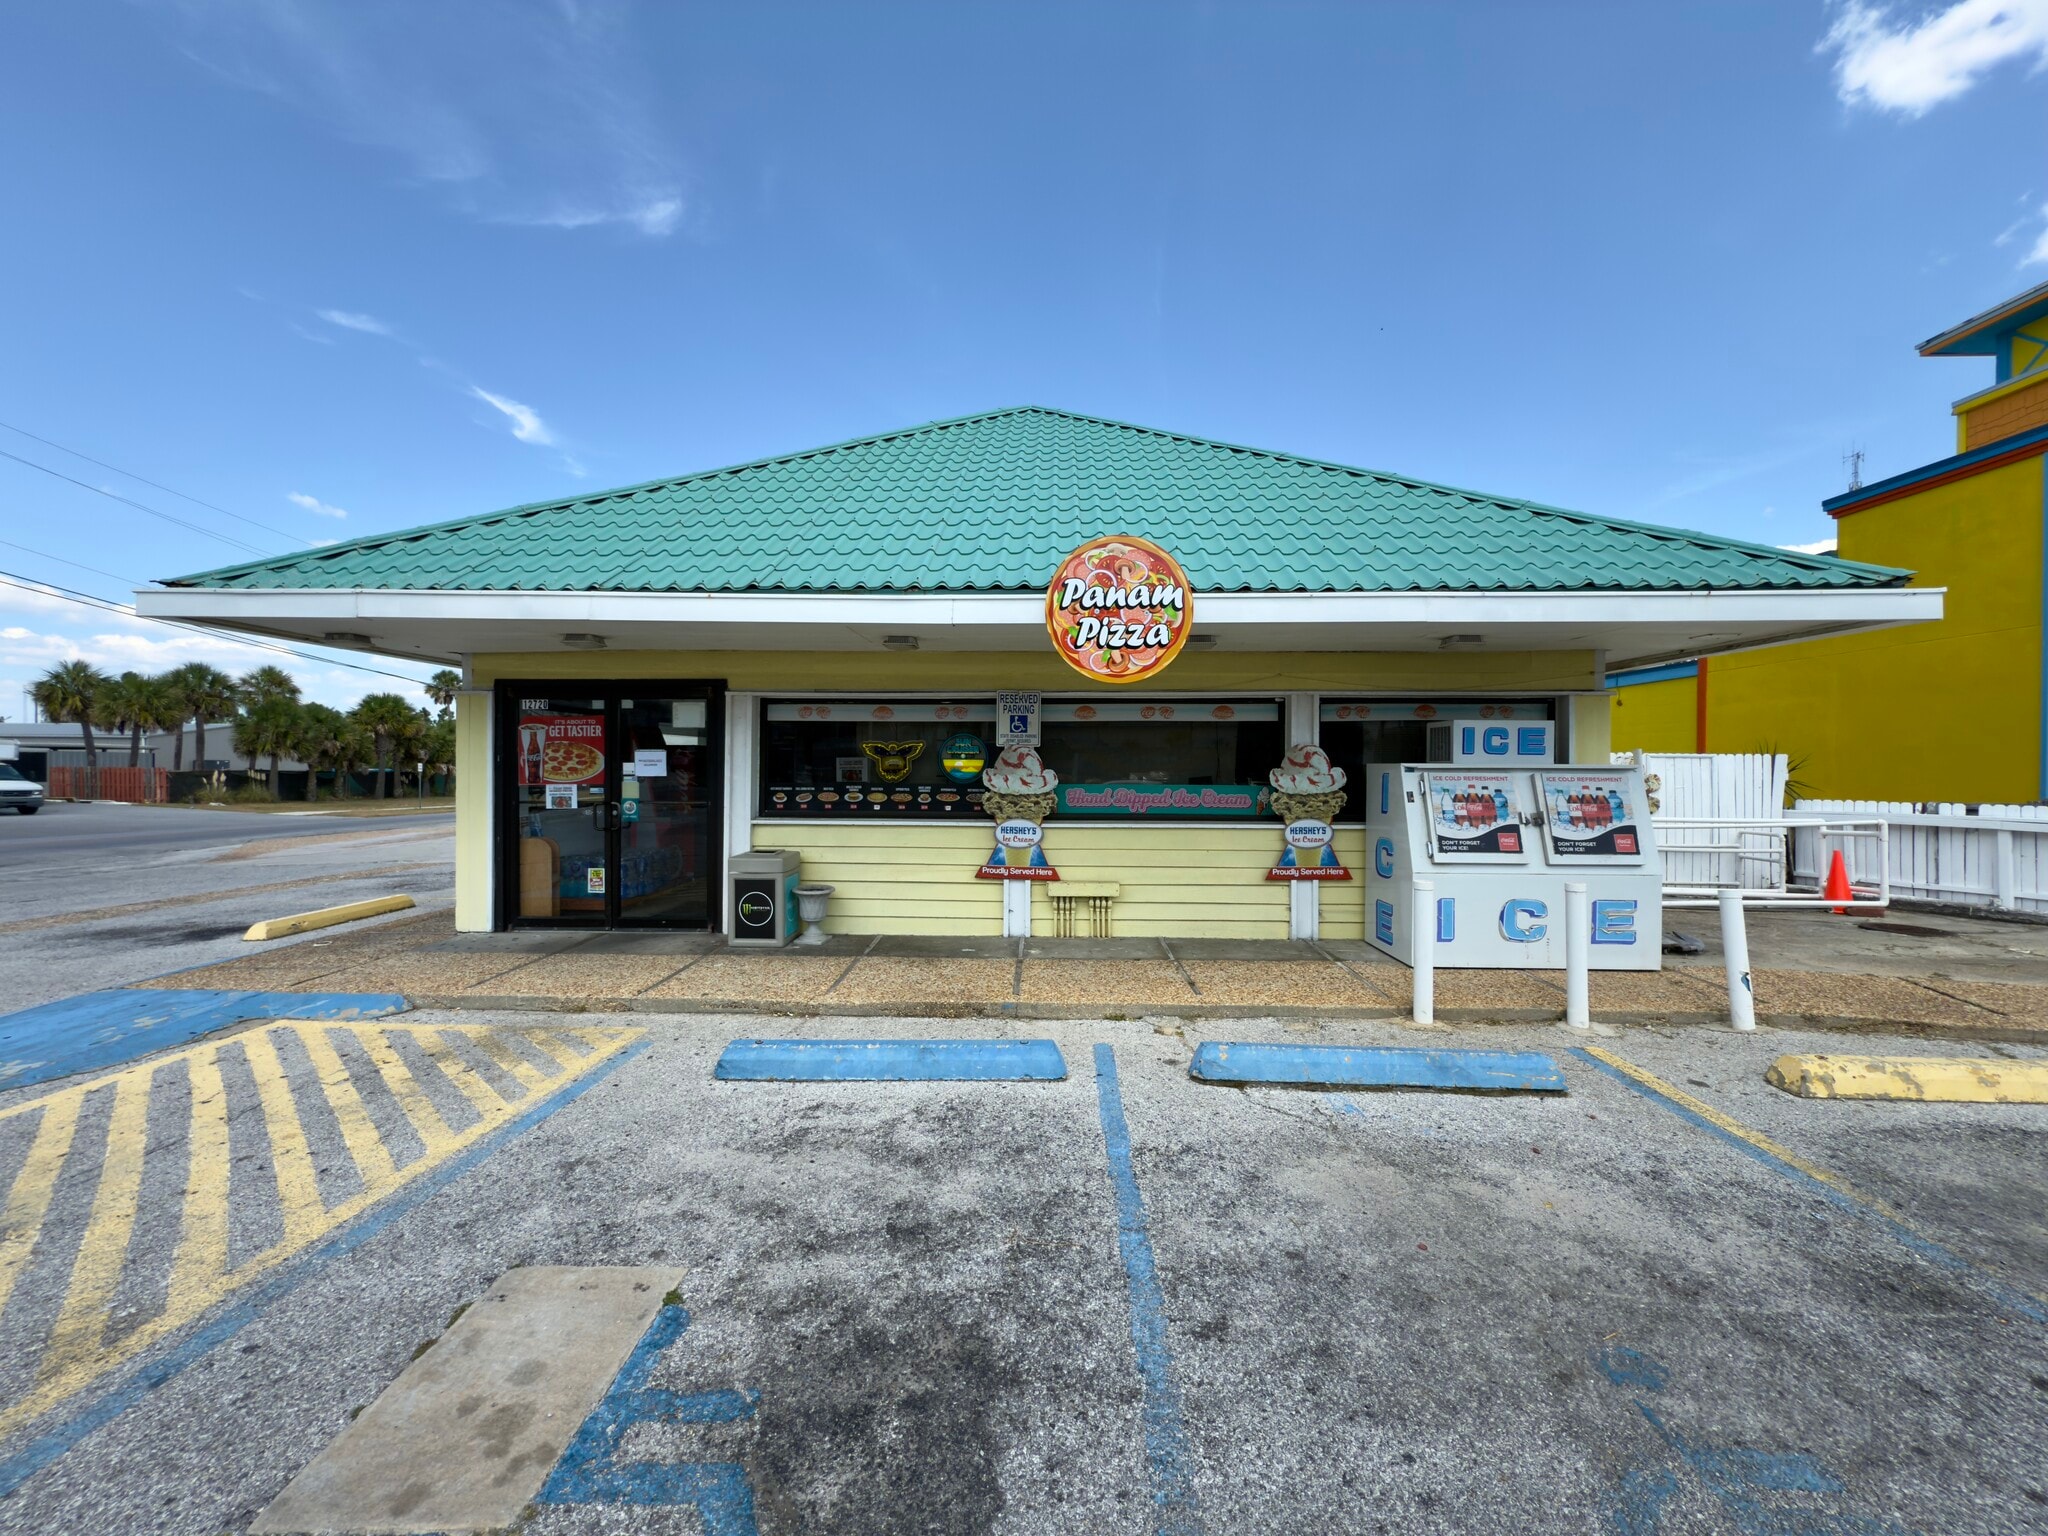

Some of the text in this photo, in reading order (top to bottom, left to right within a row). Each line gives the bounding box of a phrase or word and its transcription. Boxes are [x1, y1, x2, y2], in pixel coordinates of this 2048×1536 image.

[1060, 578, 1183, 611] Panam
[1075, 618, 1170, 649] Pizza
[1000, 694, 1038, 704] RESERVED
[524, 700, 548, 709] 12720
[1003, 705, 1035, 714] PARKING
[549, 725, 602, 737] GET TASTIER
[1462, 726, 1547, 756] ICE
[1065, 788, 1252, 813] Hand Dipped Ice Cream
[1000, 826, 1037, 835] HERSHEY'S
[1289, 826, 1327, 835] HERSHEY'S
[1002, 835, 1011, 843] Ice
[982, 867, 1053, 876] Proudly Served Here
[1272, 868, 1299, 877] Proudly
[1300, 868, 1326, 876] Served
